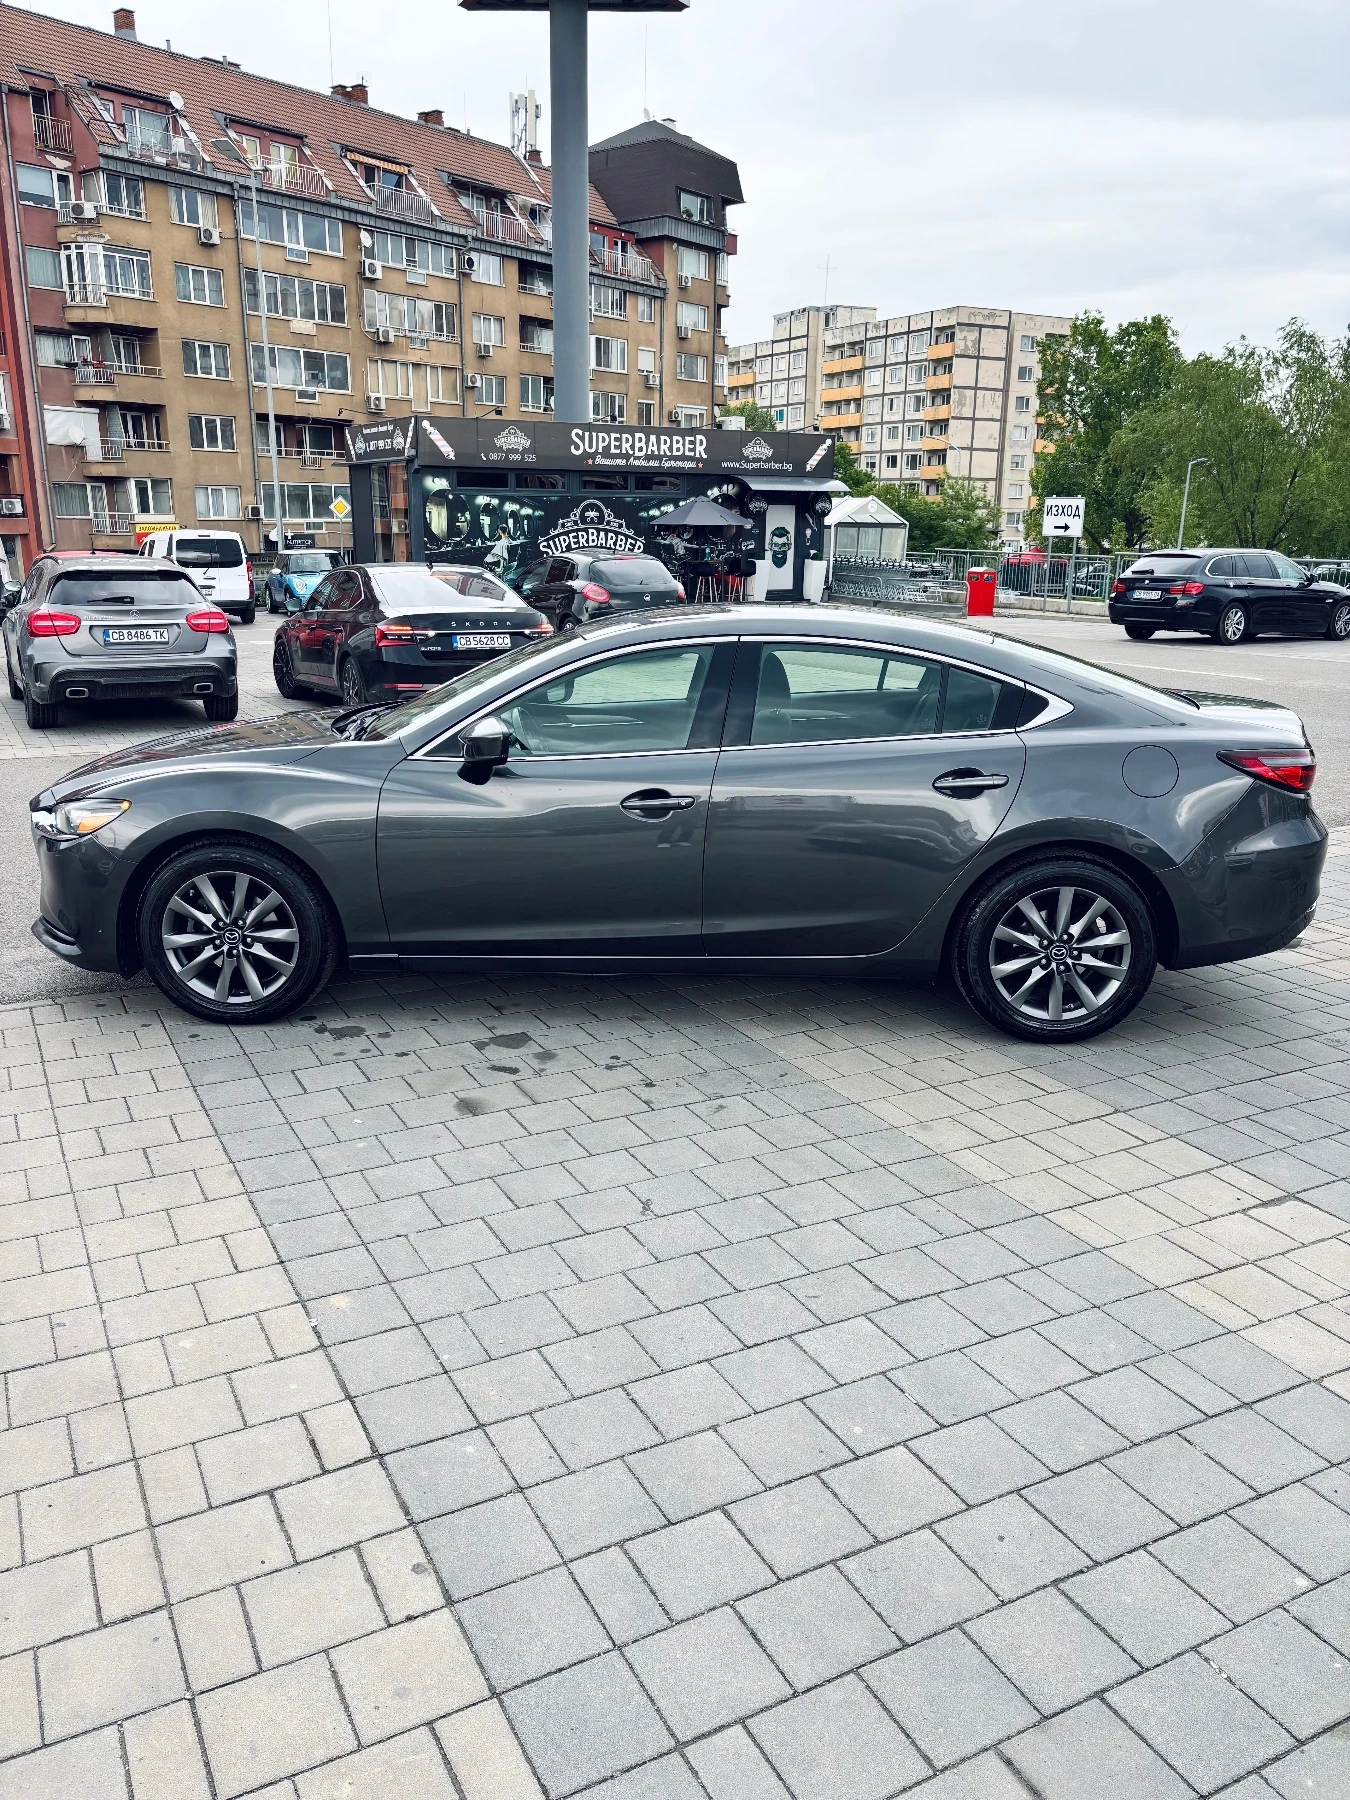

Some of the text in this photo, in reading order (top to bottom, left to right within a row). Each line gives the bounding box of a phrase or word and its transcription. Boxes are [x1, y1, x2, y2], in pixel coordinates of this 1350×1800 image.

[570, 428, 708, 459] SUPERBARBER
[489, 452, 537, 462] 0877 999 525
[721, 460, 793, 471] www.Superbarber.bg
[1046, 504, 1081, 519] ИЗХОД
[111, 630, 166, 641] CB 8486 TK
[458, 635, 509, 647] CB 5628 CC
